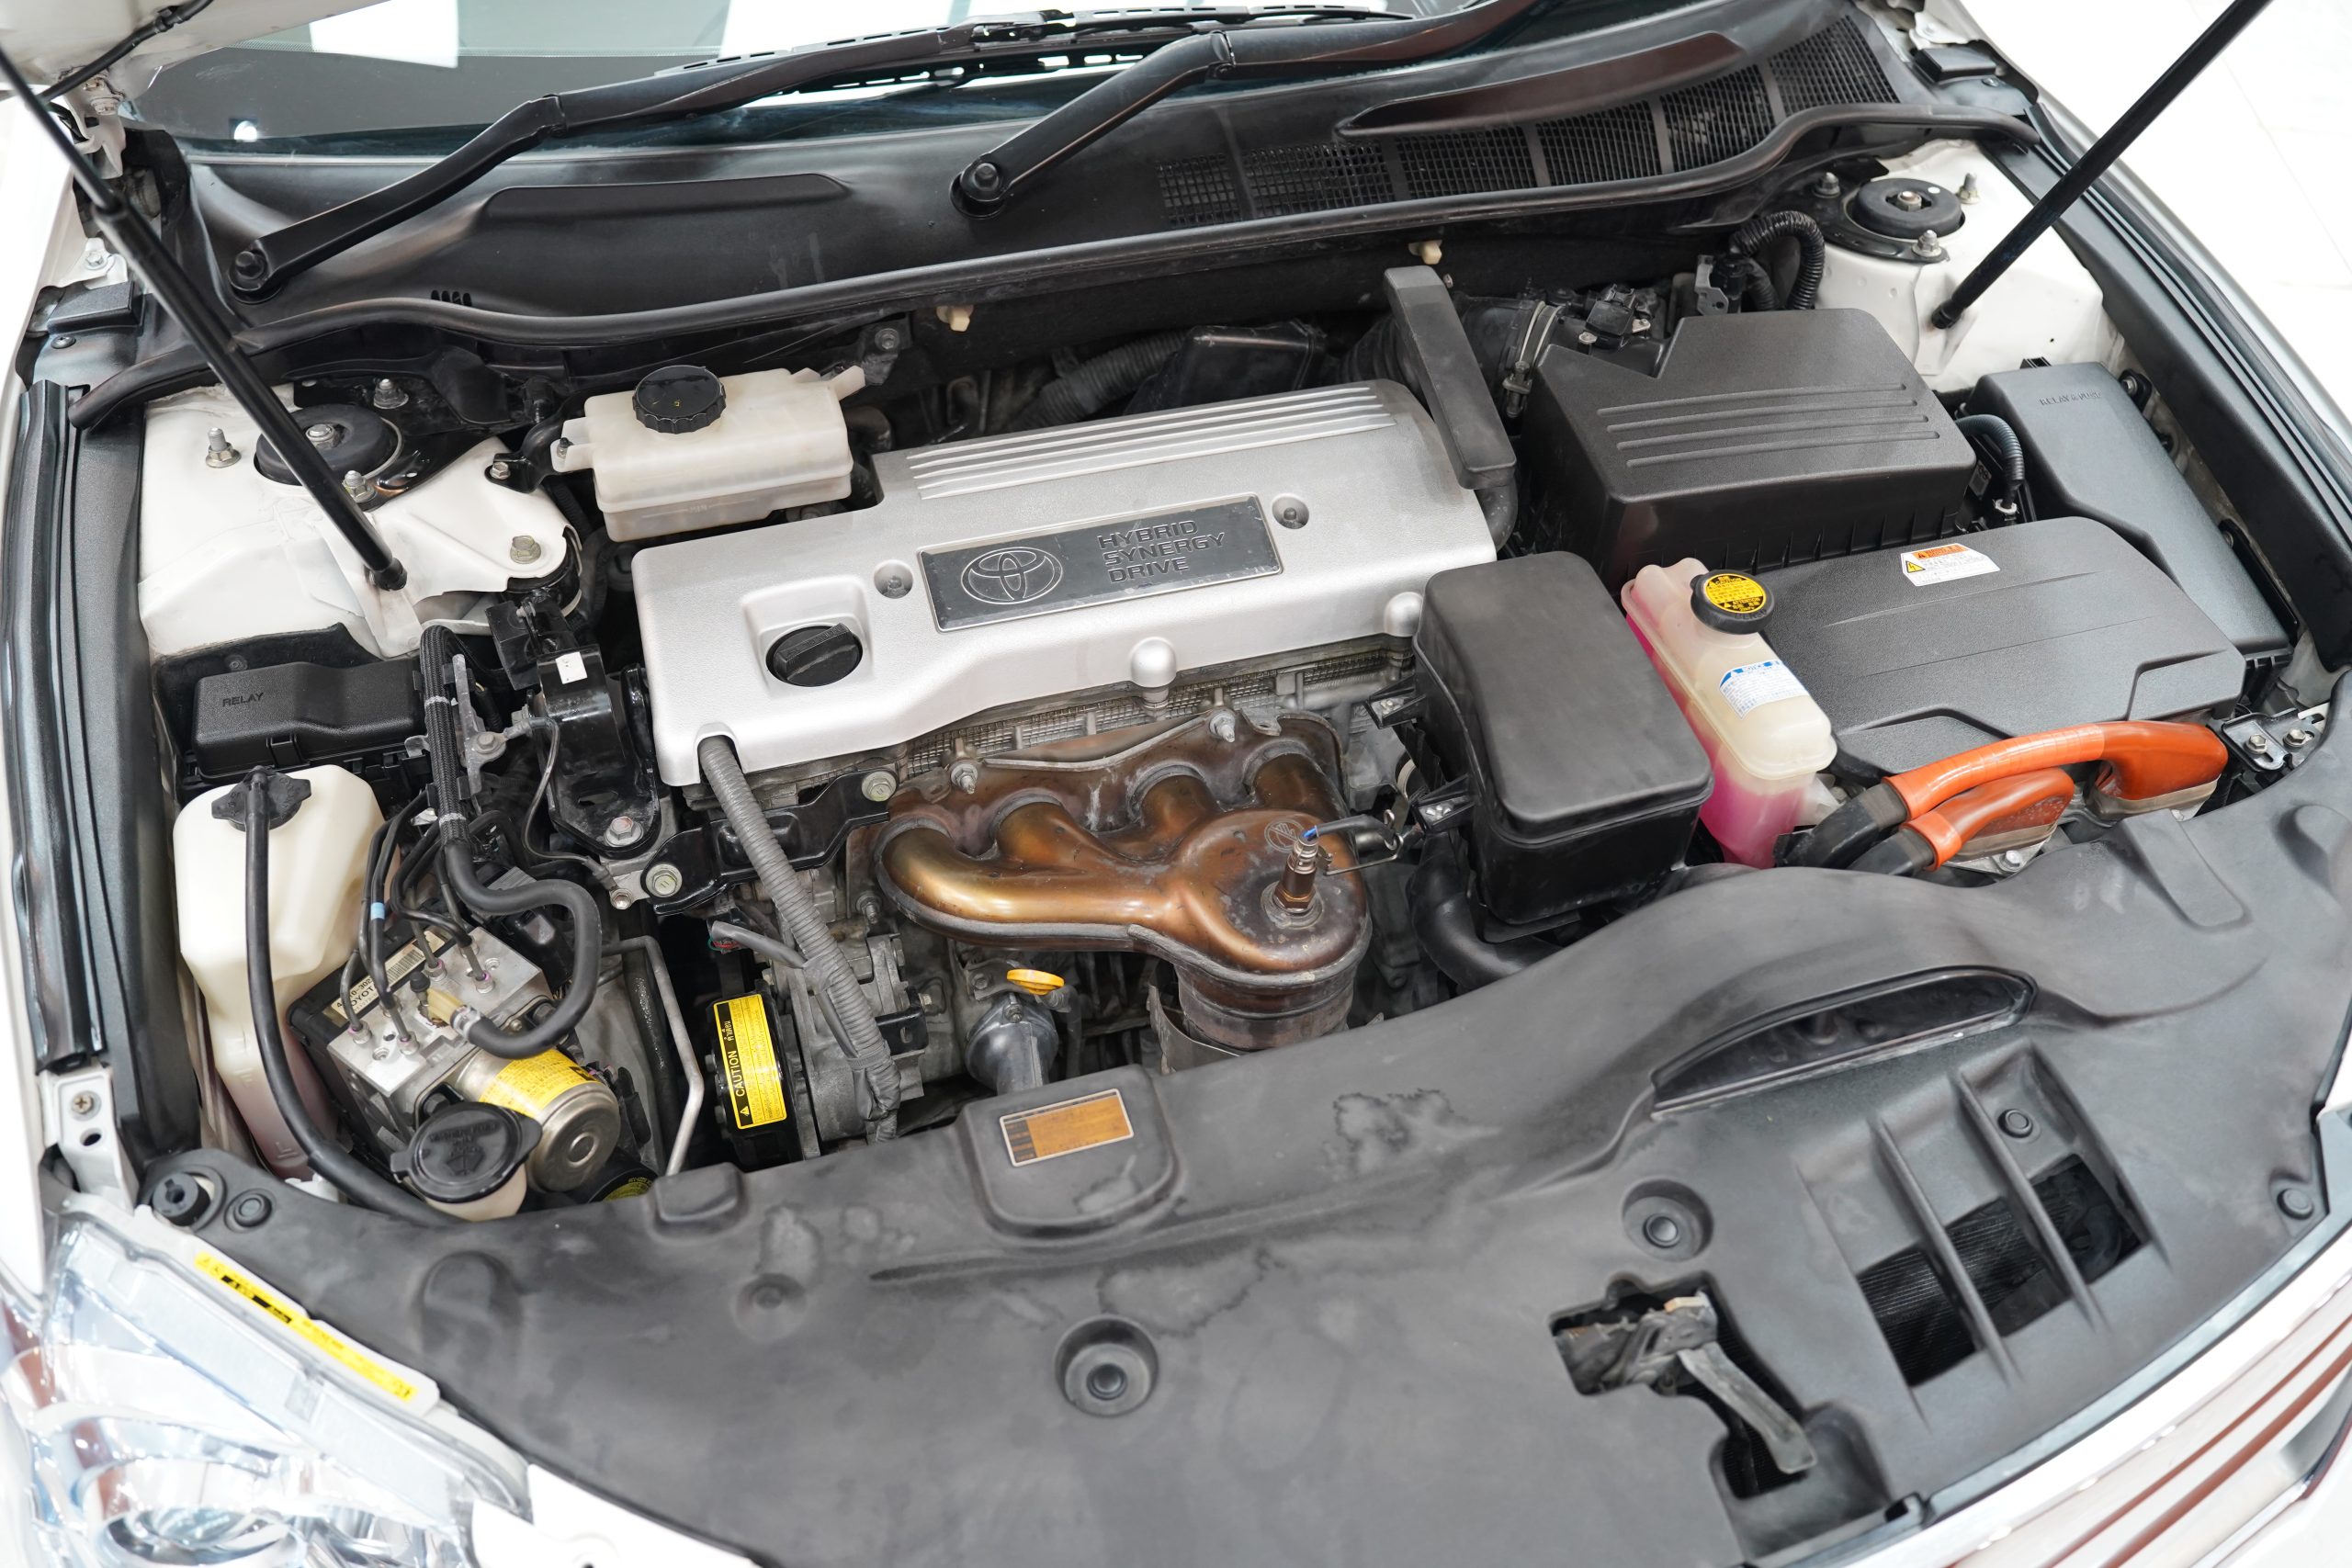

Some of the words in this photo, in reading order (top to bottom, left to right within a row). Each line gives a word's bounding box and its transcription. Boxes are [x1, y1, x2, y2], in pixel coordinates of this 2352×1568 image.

[2039, 393, 2070, 405] RELAY
[1097, 520, 1198, 550] HYBRID
[1102, 532, 1225, 567] SYNERGY
[1107, 557, 1189, 583] DRIVE
[222, 693, 264, 706] RELAY
[728, 1050, 745, 1097] CAUTION
